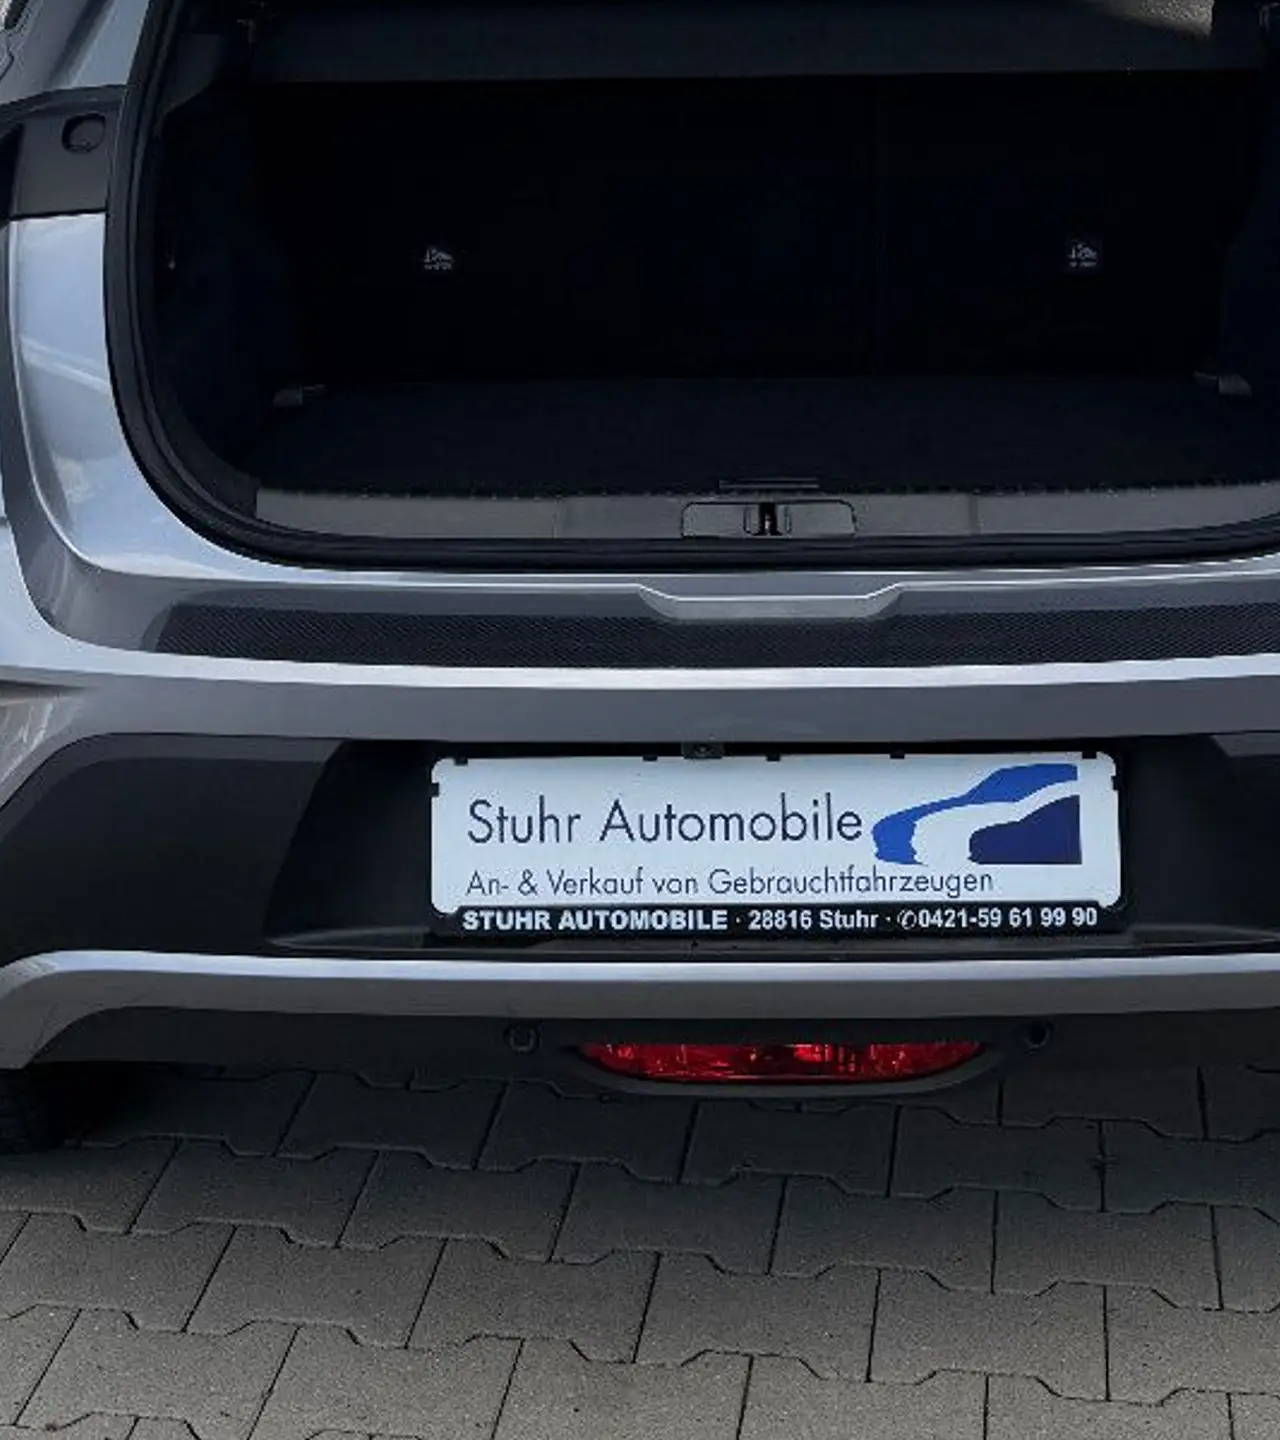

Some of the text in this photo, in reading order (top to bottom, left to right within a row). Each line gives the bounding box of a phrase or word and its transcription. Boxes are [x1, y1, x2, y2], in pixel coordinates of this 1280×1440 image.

[467, 791, 862, 843] Stuhr Automobile
[466, 864, 994, 899] An- & Verkauf von Gebrauchtfahrzeugen
[463, 906, 1097, 931] STUHR AUTOMOBILE 28816 Stuhr 0421-59 61 99 90
